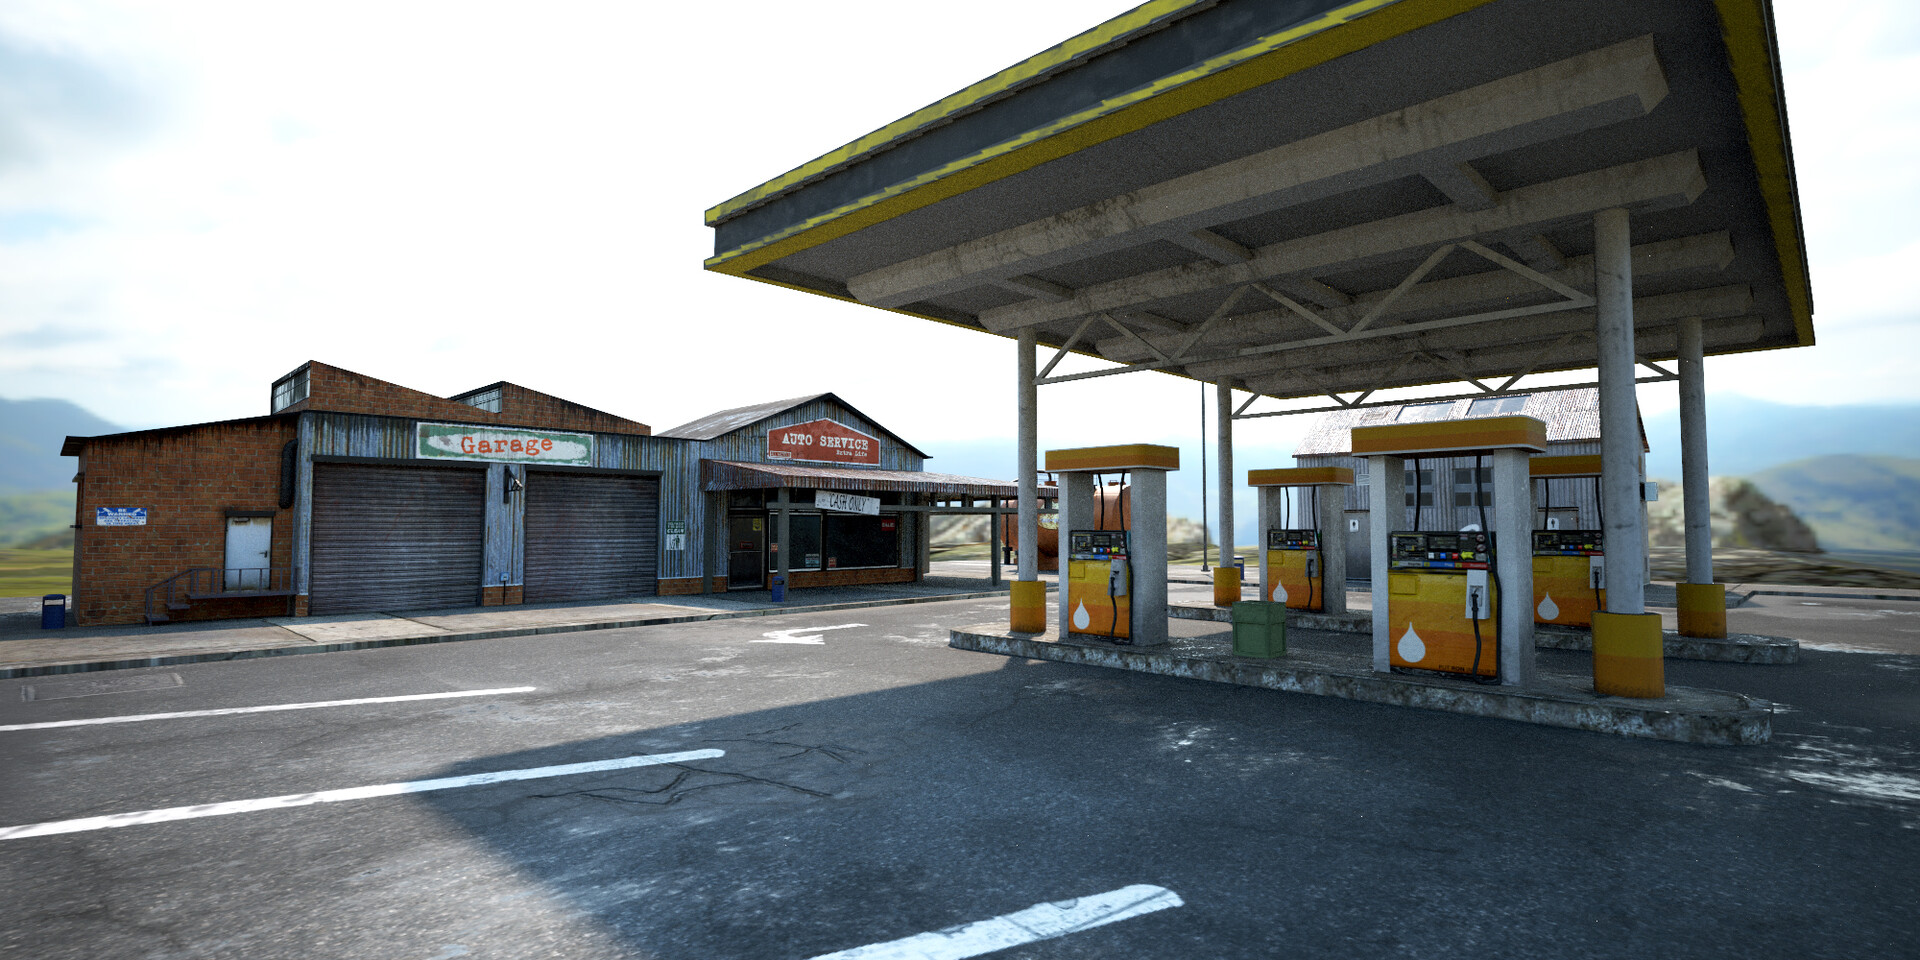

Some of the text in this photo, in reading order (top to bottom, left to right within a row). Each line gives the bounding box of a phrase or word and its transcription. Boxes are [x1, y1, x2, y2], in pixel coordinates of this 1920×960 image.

[461, 436, 553, 456] Garage
[782, 433, 869, 450] AUTO SERVICE
